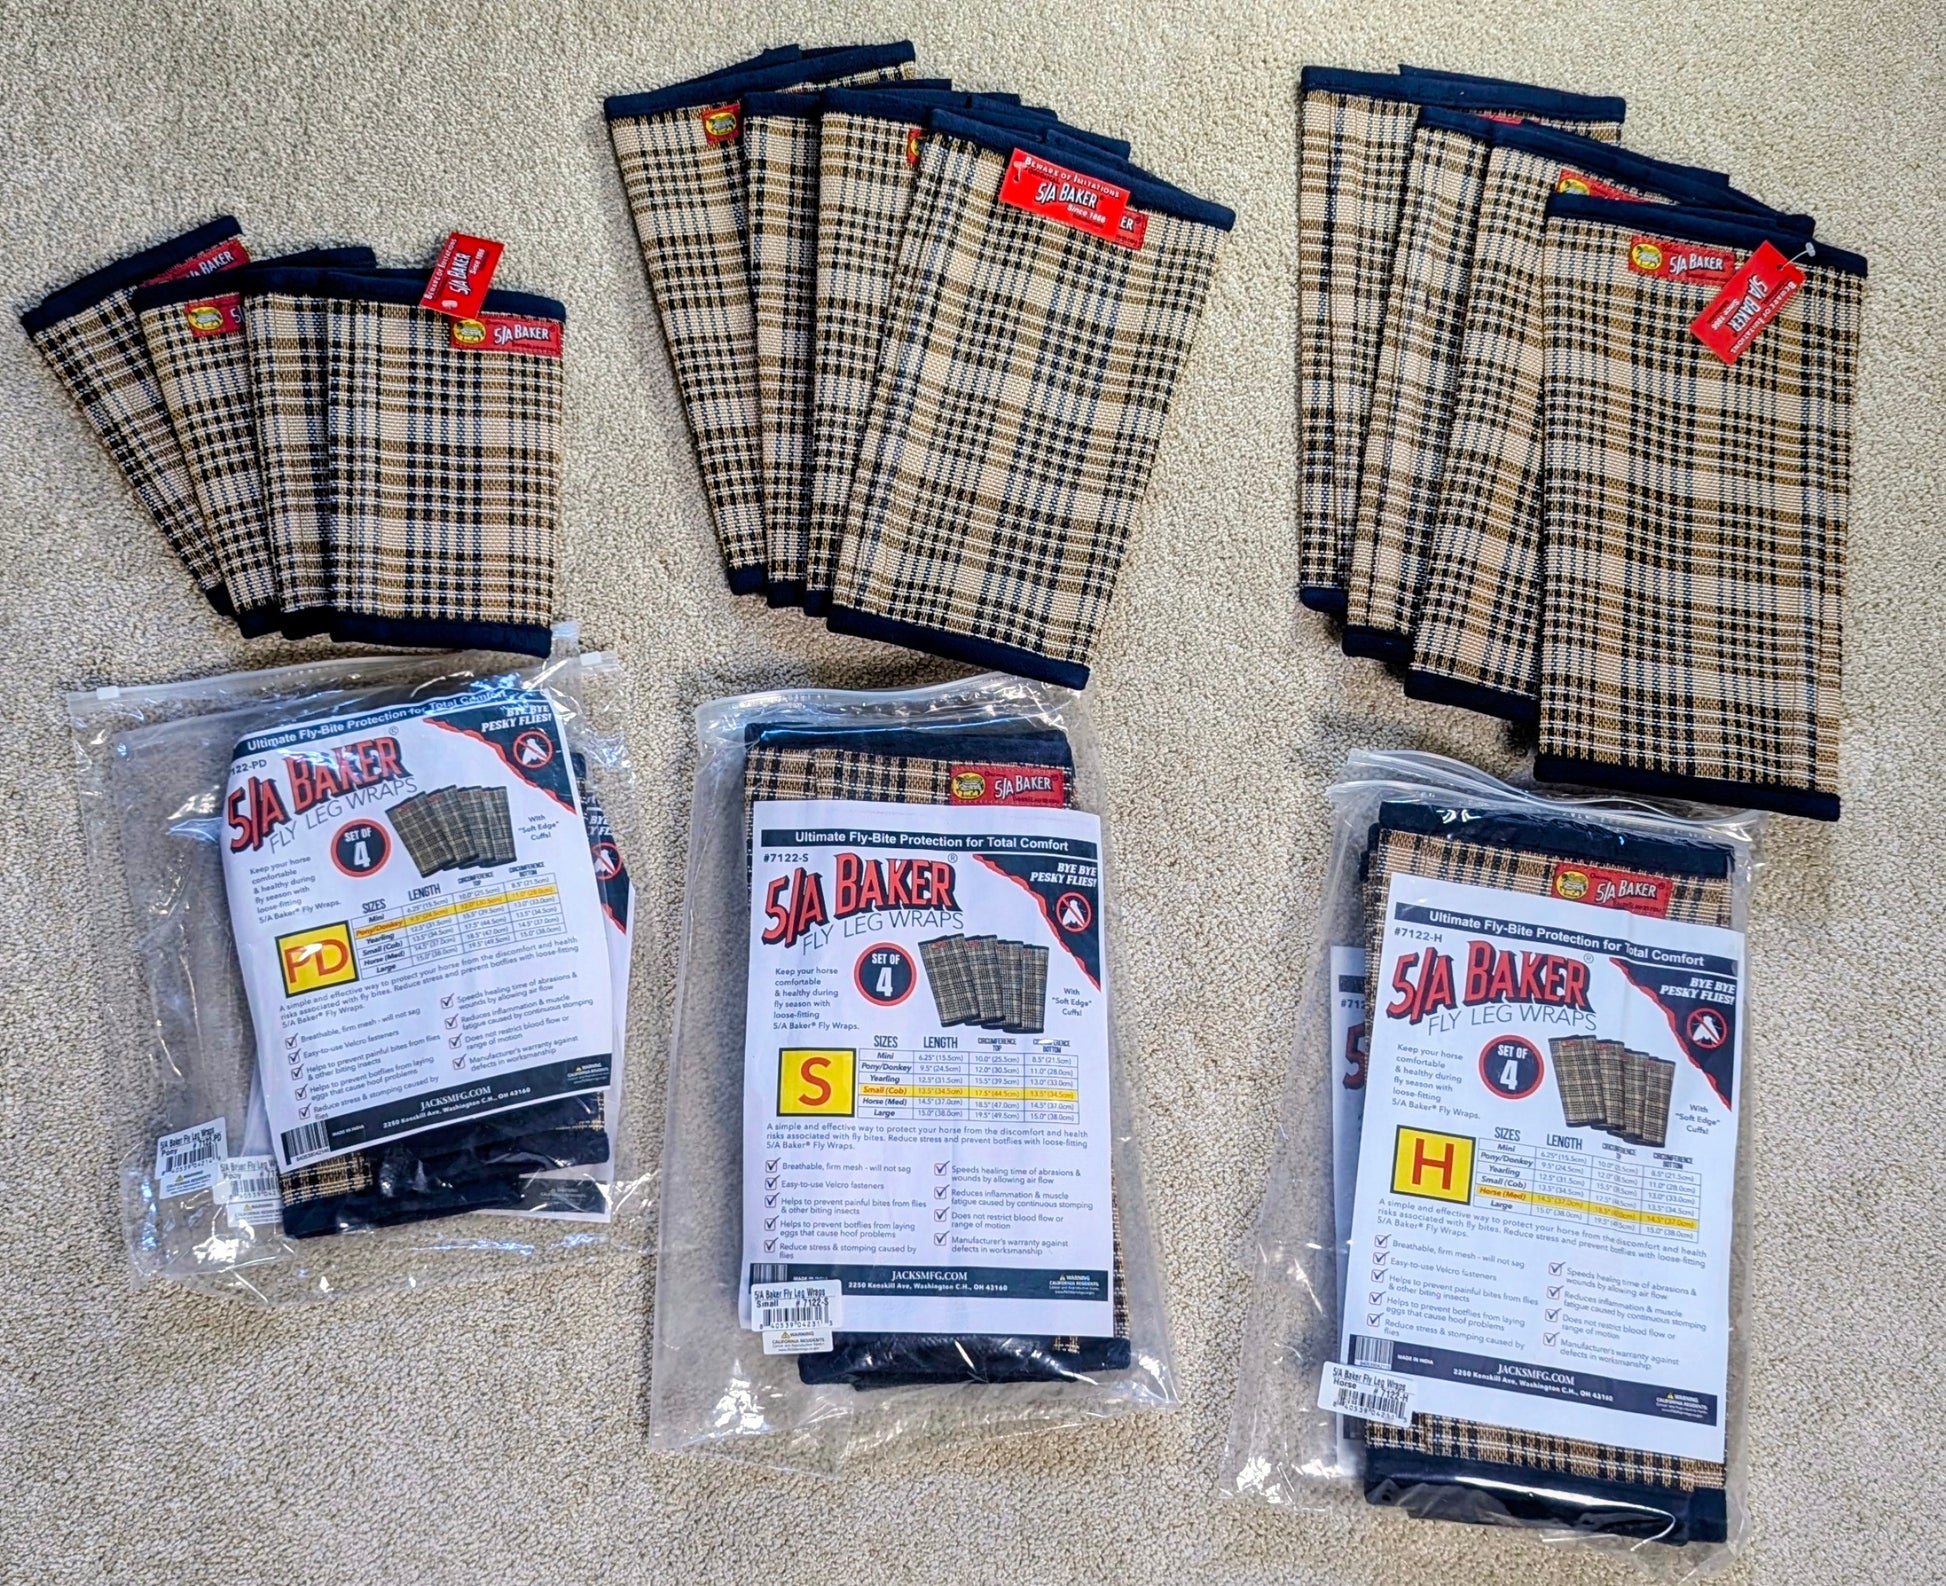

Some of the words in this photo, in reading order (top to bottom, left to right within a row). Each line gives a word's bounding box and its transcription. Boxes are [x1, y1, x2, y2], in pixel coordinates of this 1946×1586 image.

[1034, 182, 1056, 204] 5/A
[1058, 183, 1098, 209] BAKER
[447, 252, 470, 280] BAKER
[1670, 255, 1687, 275] 5/A
[1690, 253, 1723, 271] BAKER
[448, 276, 472, 295] 5/A
[1748, 275, 1768, 299] 5/A
[1727, 298, 1760, 332] BAKER
[494, 326, 513, 346] 5/A
[514, 324, 550, 340] BAKER
[247, 732, 297, 752] Ultimate
[299, 723, 344, 740] Fly-Bite
[346, 709, 408, 729] Protection
[409, 706, 426, 716] for
[430, 698, 458, 712] Total
[460, 690, 506, 706] Comfort
[481, 720, 516, 732] PESKY
[518, 713, 552, 726] FLIES!
[228, 776, 292, 854] 5/A
[283, 736, 414, 815] BAKER
[994, 778, 1014, 800] 5/A
[1016, 774, 1052, 792] BAKER
[269, 820, 297, 854] FLY
[306, 800, 343, 830] LEG
[346, 778, 418, 810] WRAPS
[344, 828, 360, 842] SET
[360, 828, 372, 838] OF
[796, 832, 846, 842] Ultimate
[850, 832, 897, 845] Fly-Bite
[900, 834, 962, 848] Protection
[966, 838, 984, 848] for
[987, 836, 1017, 848] Total
[1020, 838, 1069, 852] Comfort
[354, 841, 371, 868] 4
[764, 853, 809, 863] #7122-S
[252, 868, 297, 885] comfortable
[1030, 872, 1063, 884] PESKY
[1066, 874, 1098, 888] FLIES!
[1057, 862, 1076, 875] BYE
[1079, 864, 1098, 877] BYE
[362, 898, 386, 914] SIZES
[408, 884, 441, 902] LENGTH
[762, 866, 830, 948] 5/A
[834, 852, 964, 920] BAKER
[1596, 880, 1616, 904] 5/A
[1618, 880, 1656, 898] BAKER
[803, 924, 834, 956] FLY
[844, 912, 883, 938] LEG
[888, 911, 964, 930] WRAPS
[1394, 927, 1443, 943] #7122-H
[1429, 910, 1481, 930] Ultimate
[1484, 919, 1534, 938] Fly-Bite
[1536, 928, 1600, 950] Protection
[1603, 940, 1622, 952] for
[1624, 942, 1648, 959] Total
[1652, 950, 1704, 967] Comfort
[284, 938, 350, 984] PD
[872, 953, 886, 965] SET
[889, 954, 900, 965] OF
[774, 978, 822, 986] comfortable
[775, 968, 796, 976] Keep
[798, 968, 814, 976] your
[816, 966, 838, 975] horse
[876, 966, 894, 997] 4
[782, 989, 810, 998] healthy
[812, 989, 838, 998] during
[1386, 946, 1459, 1026] 5/A
[1462, 940, 1596, 1014] BAKER
[1690, 976, 1713, 989] BYE
[1715, 981, 1736, 994] BYE
[814, 1000, 830, 1008] with
[1660, 984, 1699, 1000] PESKY
[1700, 990, 1736, 1006] FLIES!
[1428, 1010, 1462, 1036] FLY
[1471, 1004, 1512, 1026] LEG
[1520, 1004, 1598, 1030] WRAPS
[874, 1034, 898, 1048] SIZES
[924, 1036, 958, 1049] LENGTH
[1498, 1044, 1516, 1058] SET
[1516, 1047, 1529, 1060] OF
[861, 1062, 912, 1073] Pony/Donkey
[1500, 1060, 1518, 1090] 4
[798, 1056, 832, 1106] S
[863, 1085, 884, 1094] Small
[885, 1086, 908, 1096] (Cob)
[420, 1085, 492, 1111] JACKSMFG.COM
[874, 1108, 896, 1118] Large
[1494, 1126, 1520, 1142] SIZES
[1546, 1133, 1582, 1150] LENGTH
[1412, 1138, 1454, 1190] H
[891, 1270, 968, 1282] JACKSMFG.COM
[1497, 1364, 1575, 1386] JACKSMFG.COM
